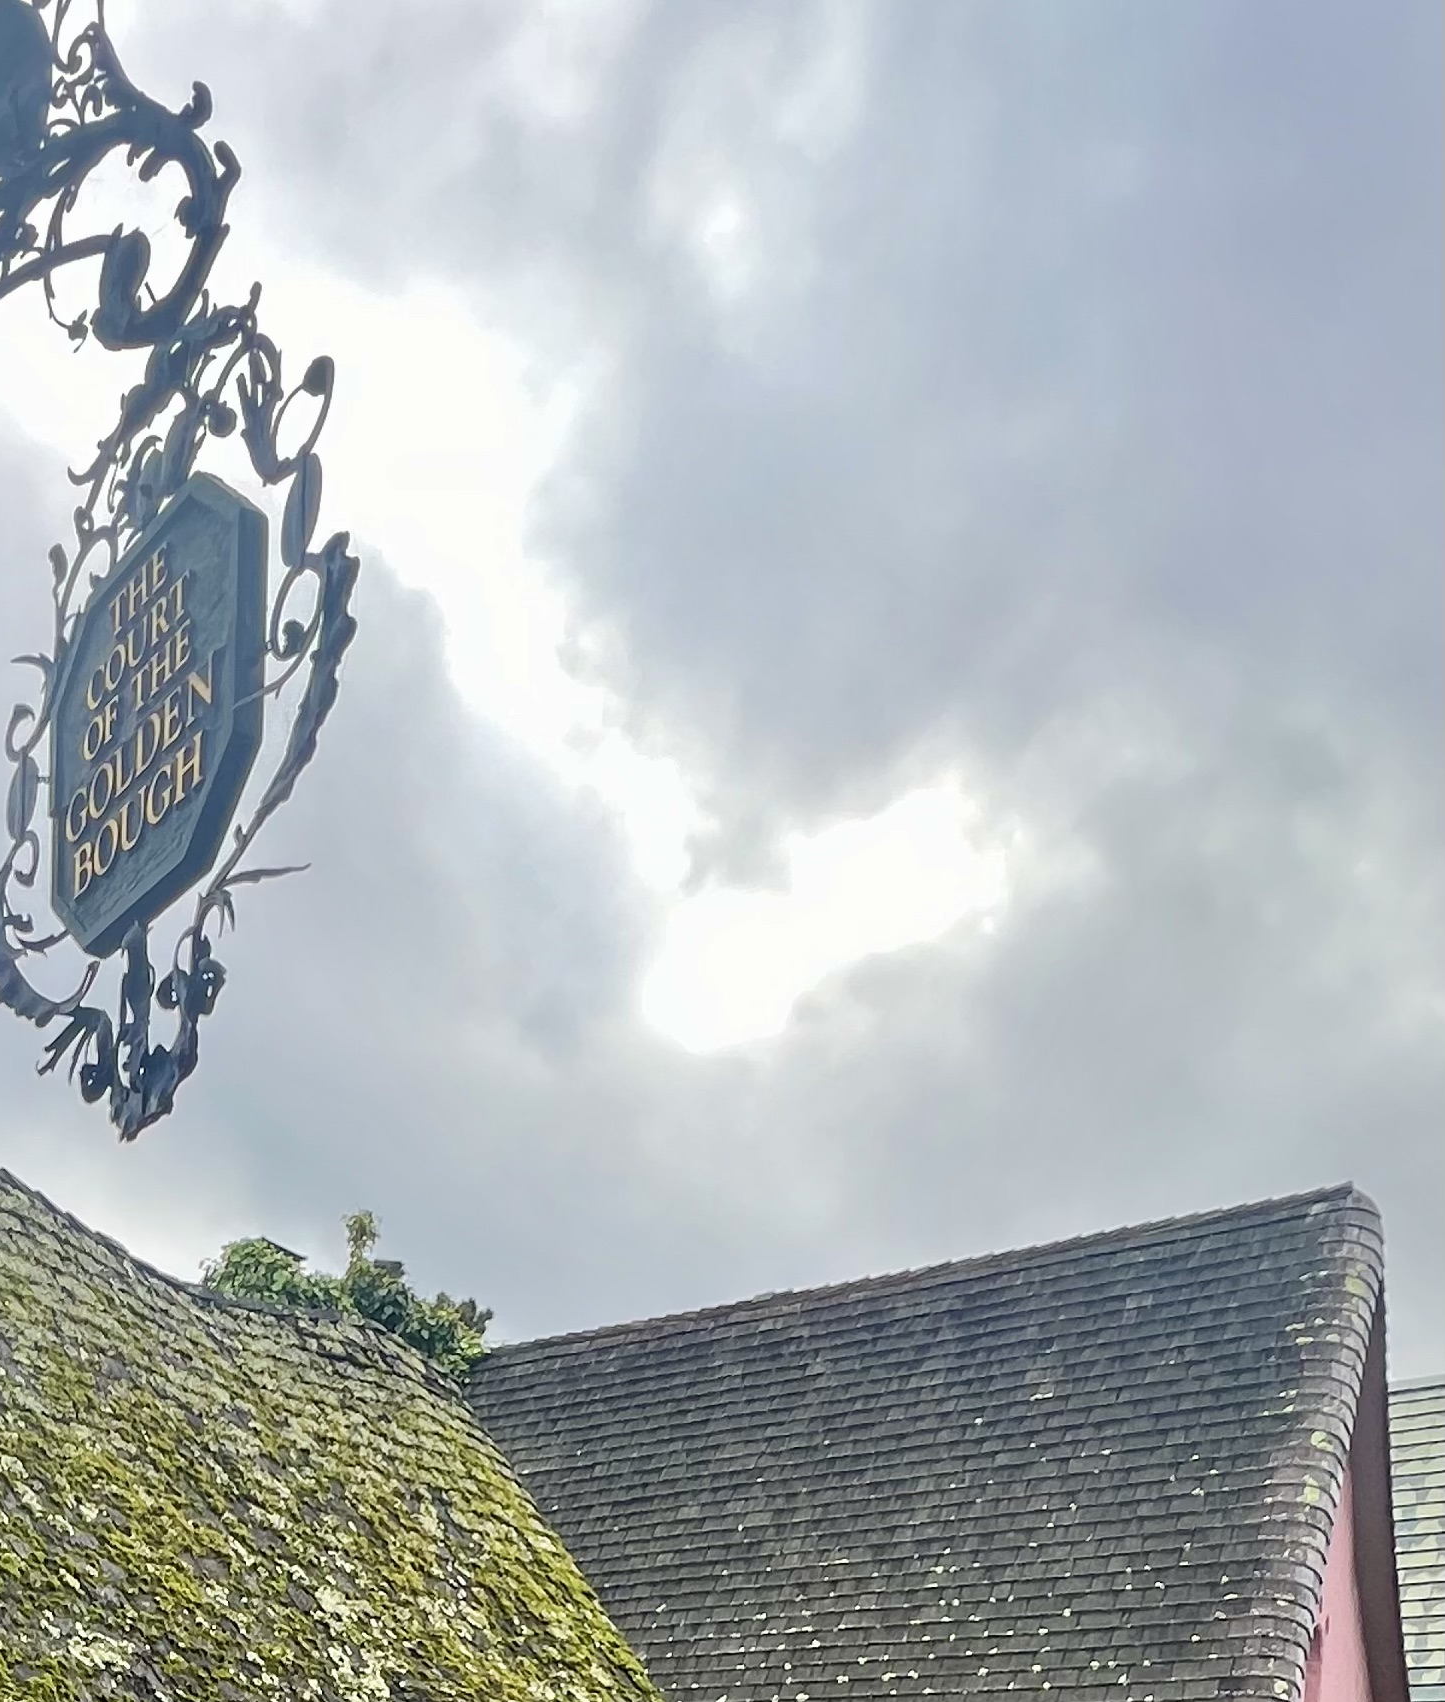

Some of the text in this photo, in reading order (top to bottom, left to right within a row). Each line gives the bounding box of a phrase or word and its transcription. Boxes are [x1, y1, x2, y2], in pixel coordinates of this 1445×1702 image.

[87, 569, 192, 711] COURT
[109, 541, 168, 636] THE
[65, 650, 215, 843] GOLDEN
[82, 618, 192, 761] OF THE
[73, 730, 205, 899] BOUGH
